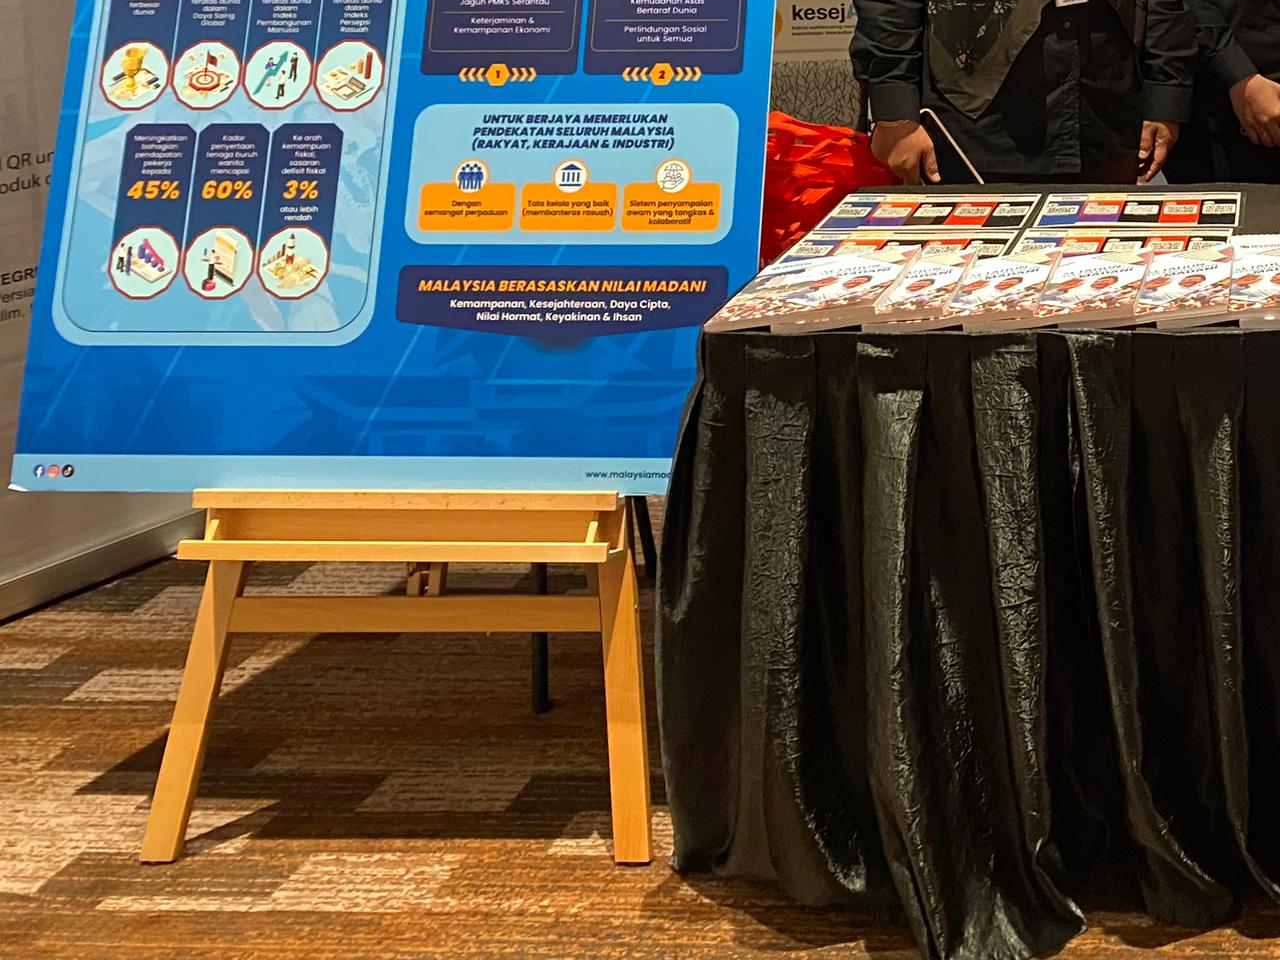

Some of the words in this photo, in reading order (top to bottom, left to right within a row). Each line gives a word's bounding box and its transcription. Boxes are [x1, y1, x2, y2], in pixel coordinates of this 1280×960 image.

[636, 6, 670, 14] Bertaraf
[672, 6, 698, 14] Dunia
[470, 16, 525, 26] Keterjaminan
[527, 16, 534, 26] &
[454, 26, 514, 36] Kemampanan
[514, 26, 551, 36] Ekonomi
[624, 24, 680, 34] Perlindungan
[681, 24, 708, 34] Sosial
[637, 34, 661, 42] untuk
[662, 34, 693, 42] Semua
[495, 70, 501, 79] 1
[659, 70, 666, 80] 2
[483, 114, 525, 124] UNTUK
[526, 114, 582, 124] BERJAYA
[583, 114, 668, 124] MEMERLUKAN
[473, 126, 554, 136] PENDEKATAN
[556, 126, 610, 136] SELURUH
[611, 126, 674, 136] MALAYSIA
[472, 138, 530, 150] (RAKYAT,
[532, 138, 600, 150] KERAJAAN
[602, 138, 610, 150] &
[612, 138, 674, 150] INDUSTRI)
[6, 152, 31, 170] QR
[126, 180, 180, 200] 45%
[202, 180, 253, 200] 60%
[282, 180, 318, 200] 3%
[418, 280, 496, 293] MALAYSIA
[498, 280, 600, 293] BERASASKAN
[601, 280, 642, 293] NILAI
[642, 280, 706, 293] MADANI
[450, 300, 528, 312] Kemampanan,
[529, 300, 608, 312] Kesejahteraan,
[610, 300, 637, 312] Daya
[639, 300, 671, 312] Cipta,
[476, 312, 500, 323] Nilai
[502, 312, 544, 323] Hormat,
[546, 312, 600, 323] Keyakinan
[602, 312, 610, 323] &
[612, 312, 642, 323] Ihsan
